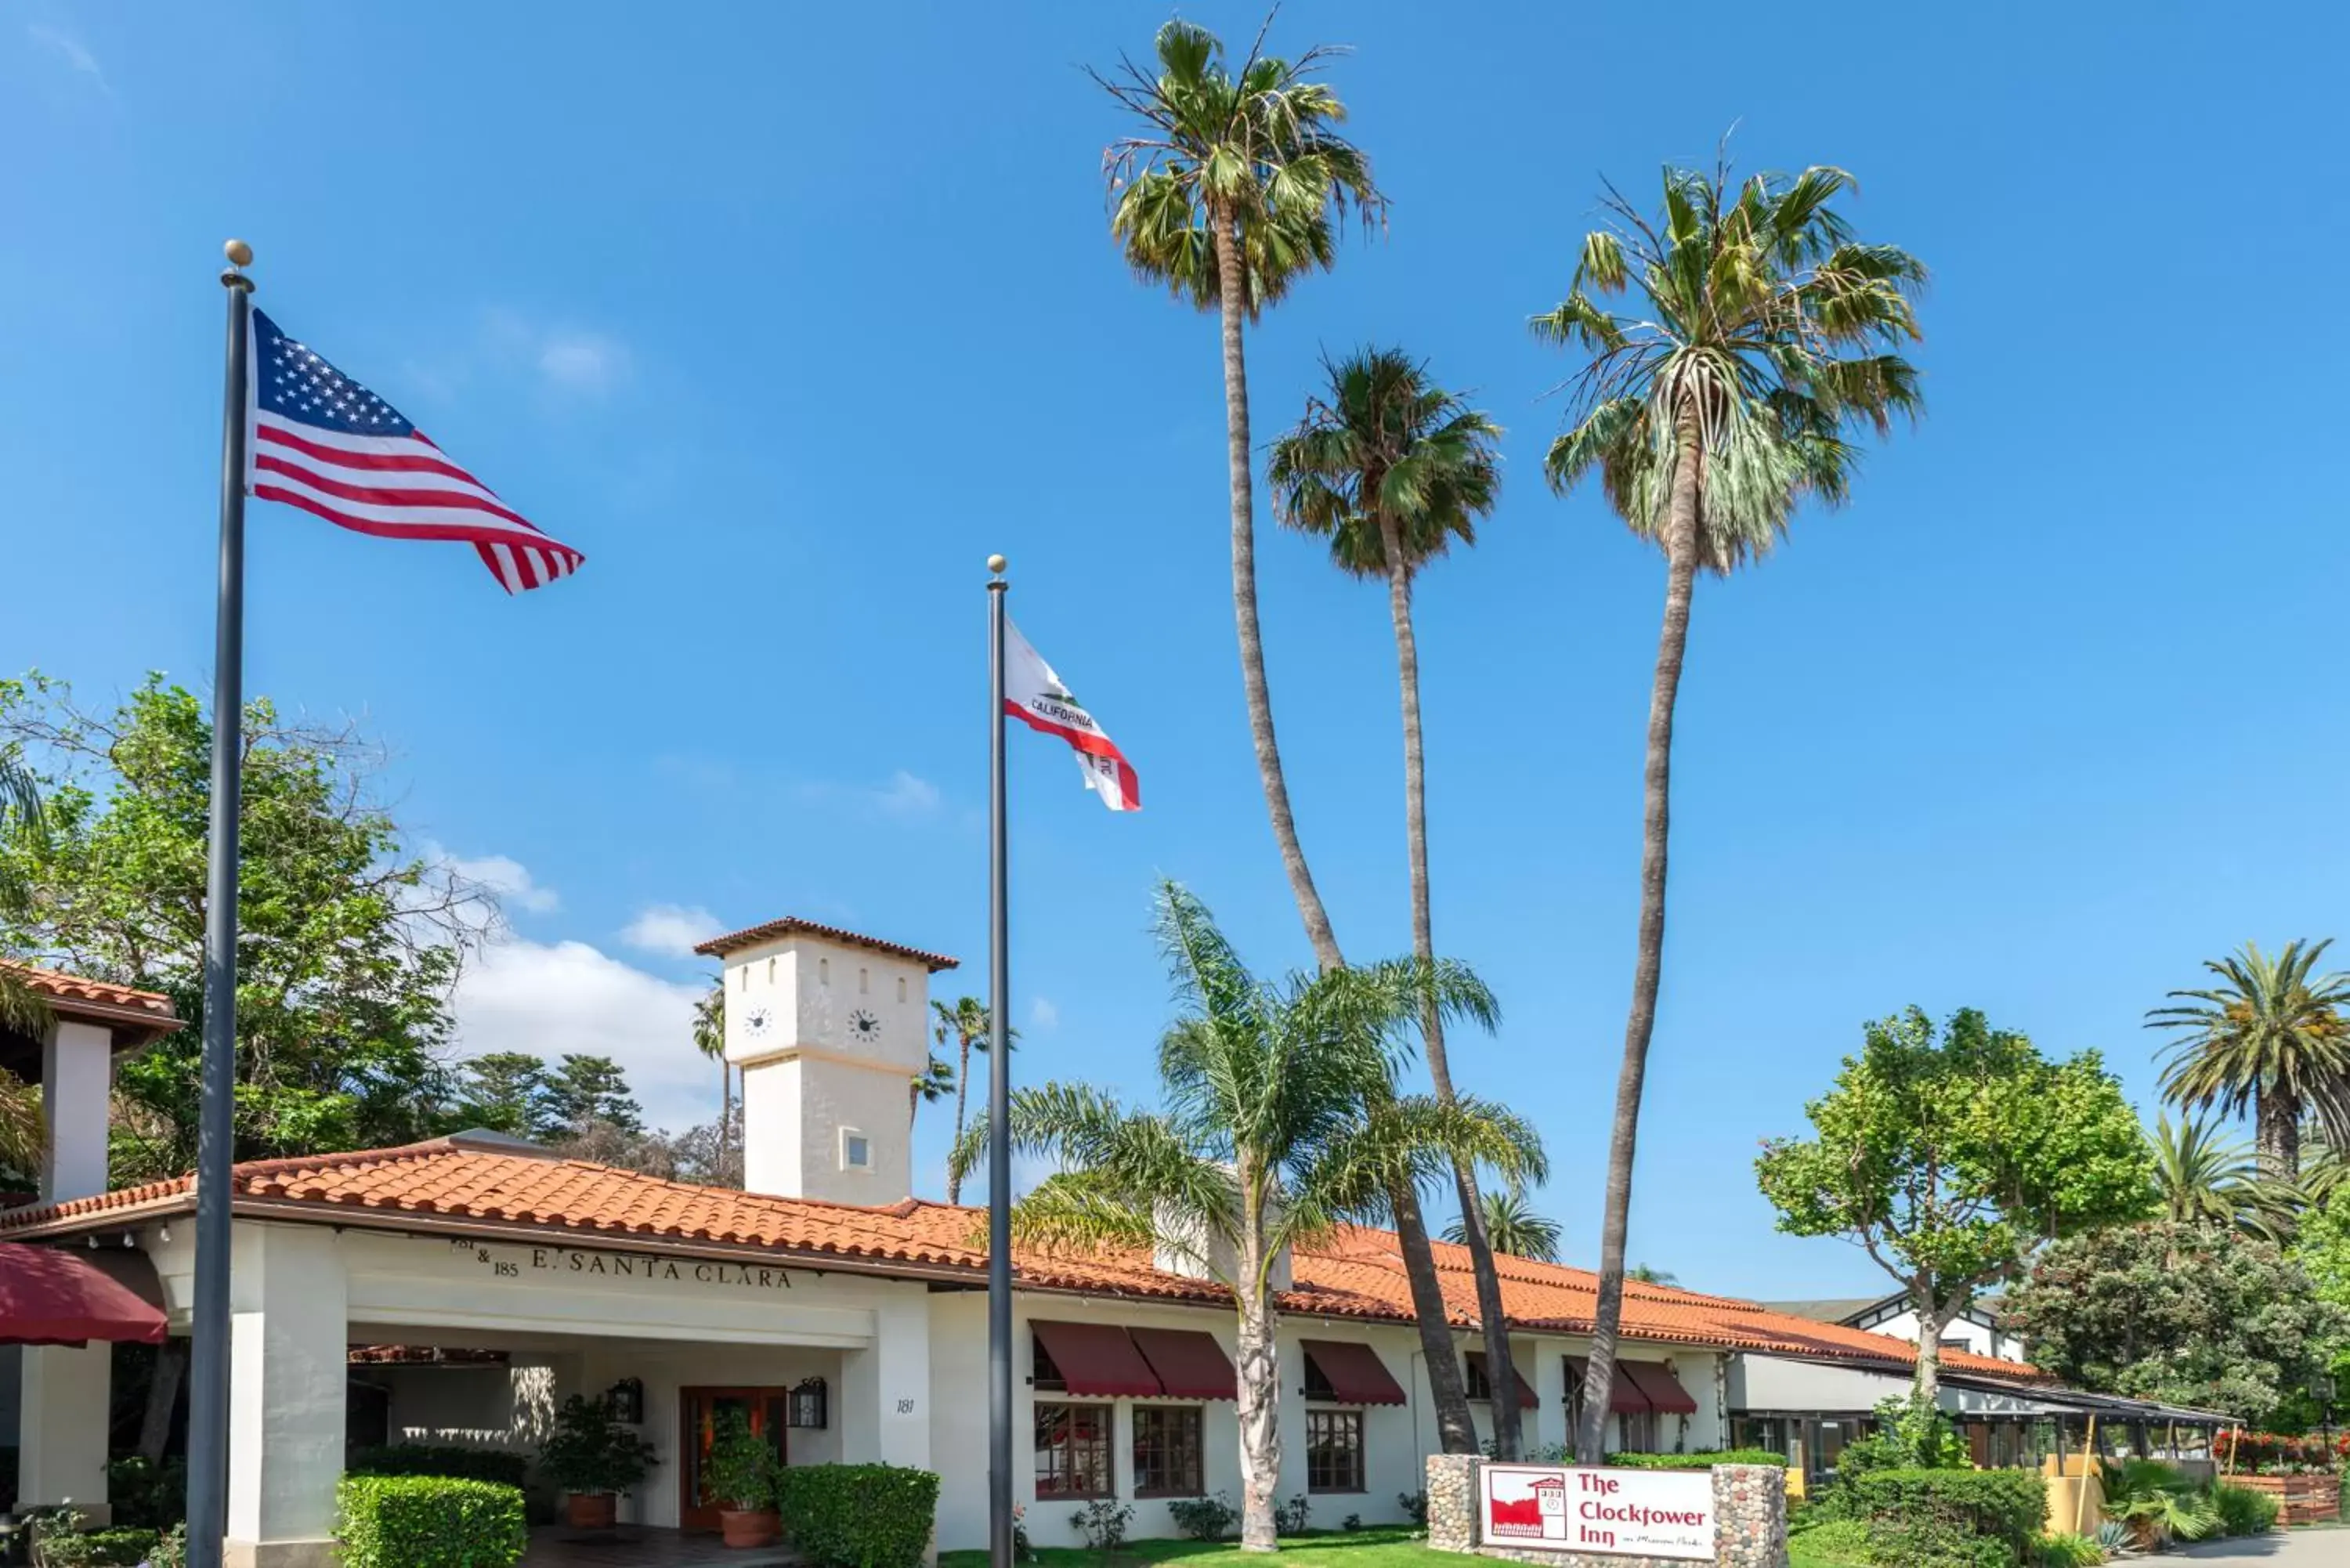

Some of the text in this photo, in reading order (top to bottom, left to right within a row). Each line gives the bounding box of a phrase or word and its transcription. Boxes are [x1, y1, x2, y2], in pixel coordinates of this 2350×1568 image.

[1032, 696, 1094, 728] CALIFORNIA
[477, 1248, 490, 1263] &
[495, 1261, 519, 1277] 185
[569, 1253, 680, 1280] SANTA
[695, 1263, 792, 1288] CLARA
[897, 1399, 915, 1414] 181
[1578, 1473, 1620, 1497] The
[1579, 1501, 1707, 1527] Clocktower
[1579, 1524, 1615, 1548] Inn
